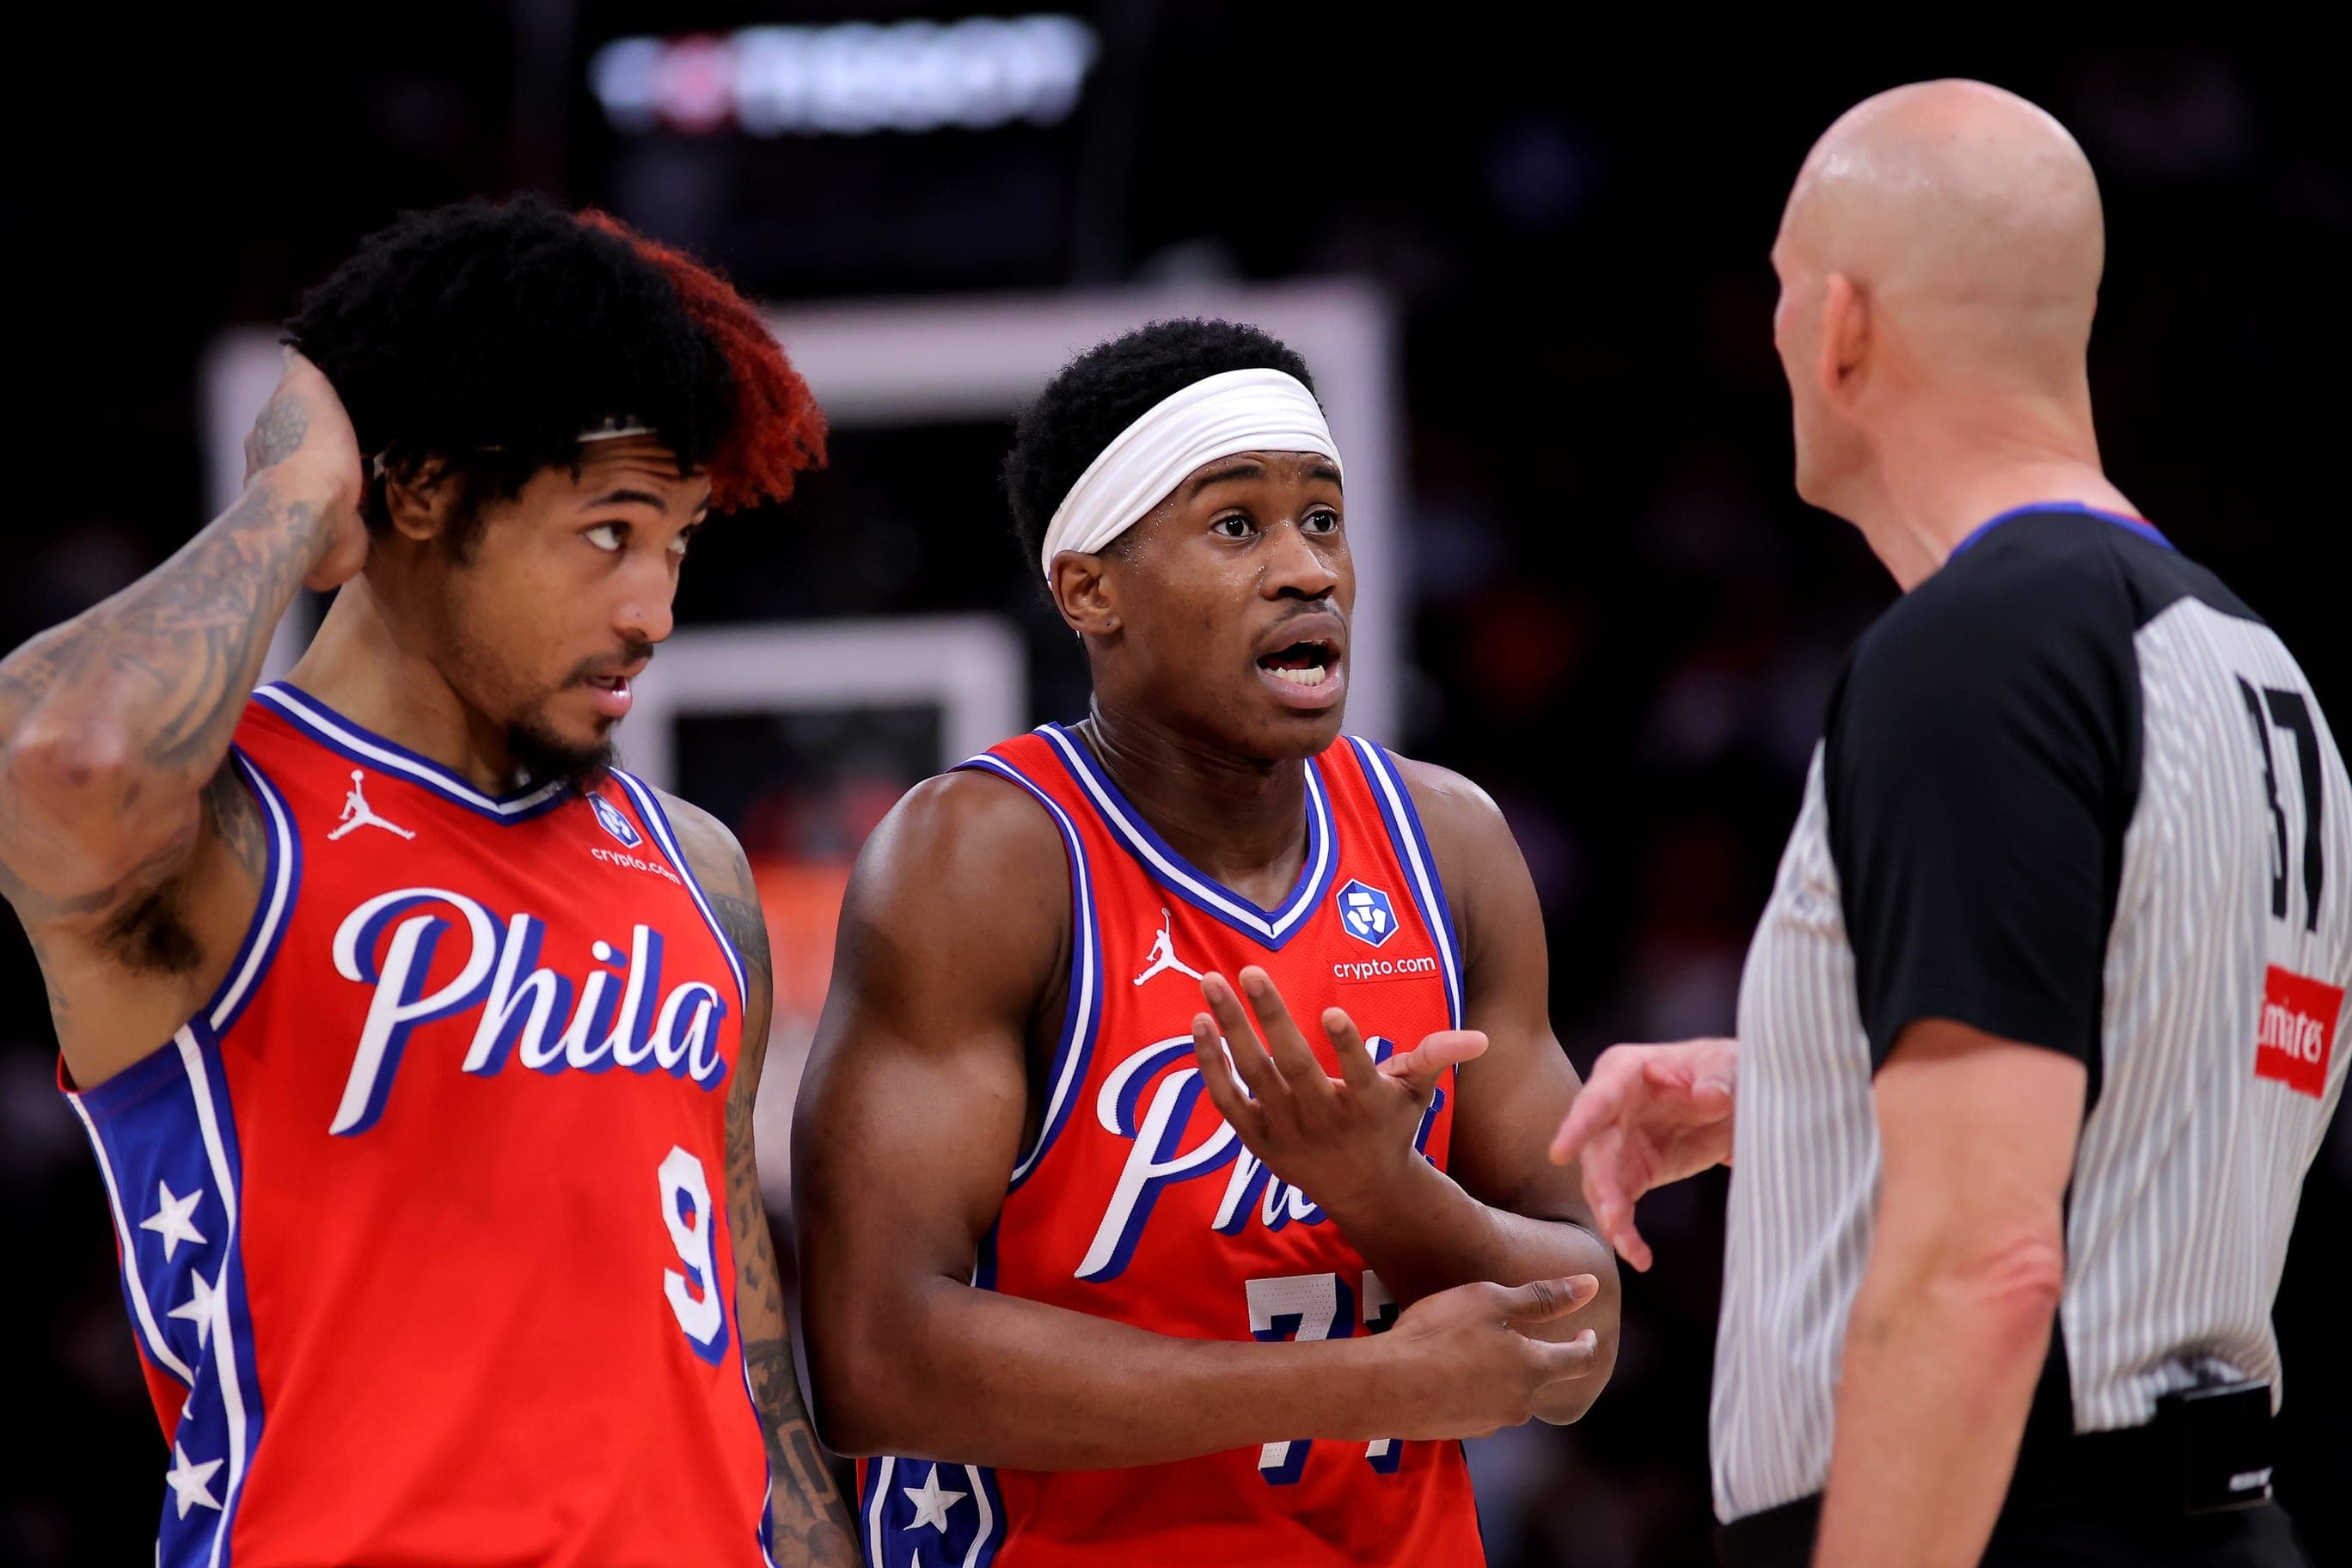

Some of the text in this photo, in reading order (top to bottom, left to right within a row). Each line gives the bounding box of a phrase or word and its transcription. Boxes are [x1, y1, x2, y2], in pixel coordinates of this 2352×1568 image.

[591, 848, 681, 885] crypto.com
[328, 887, 727, 1136] Phila
[1333, 956, 1436, 980] crypto.com
[658, 1144, 729, 1367] 9
